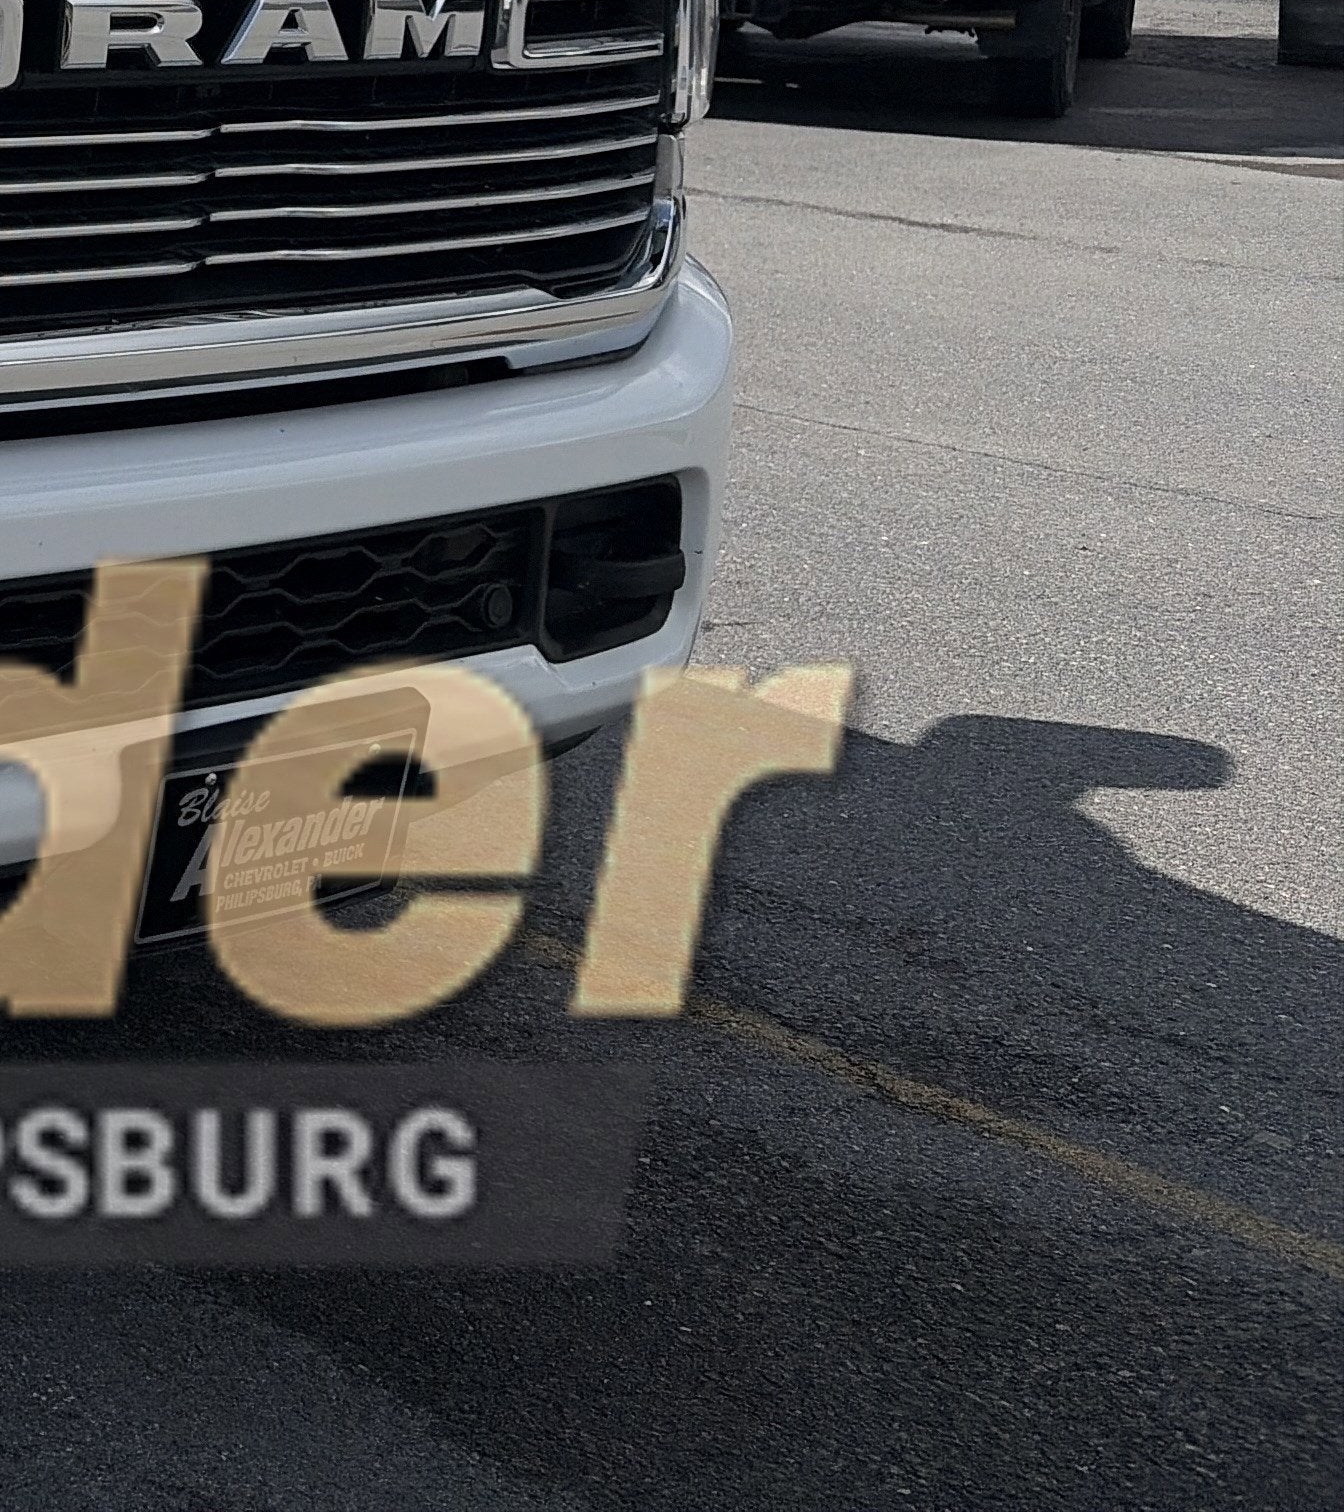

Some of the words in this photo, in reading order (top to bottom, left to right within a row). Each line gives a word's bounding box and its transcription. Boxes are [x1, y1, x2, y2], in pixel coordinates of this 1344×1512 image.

[177, 788, 271, 827] Blaise
[169, 795, 386, 903] Alexander
[223, 856, 309, 890] CHEVROLET
[323, 843, 365, 868] BUICK
